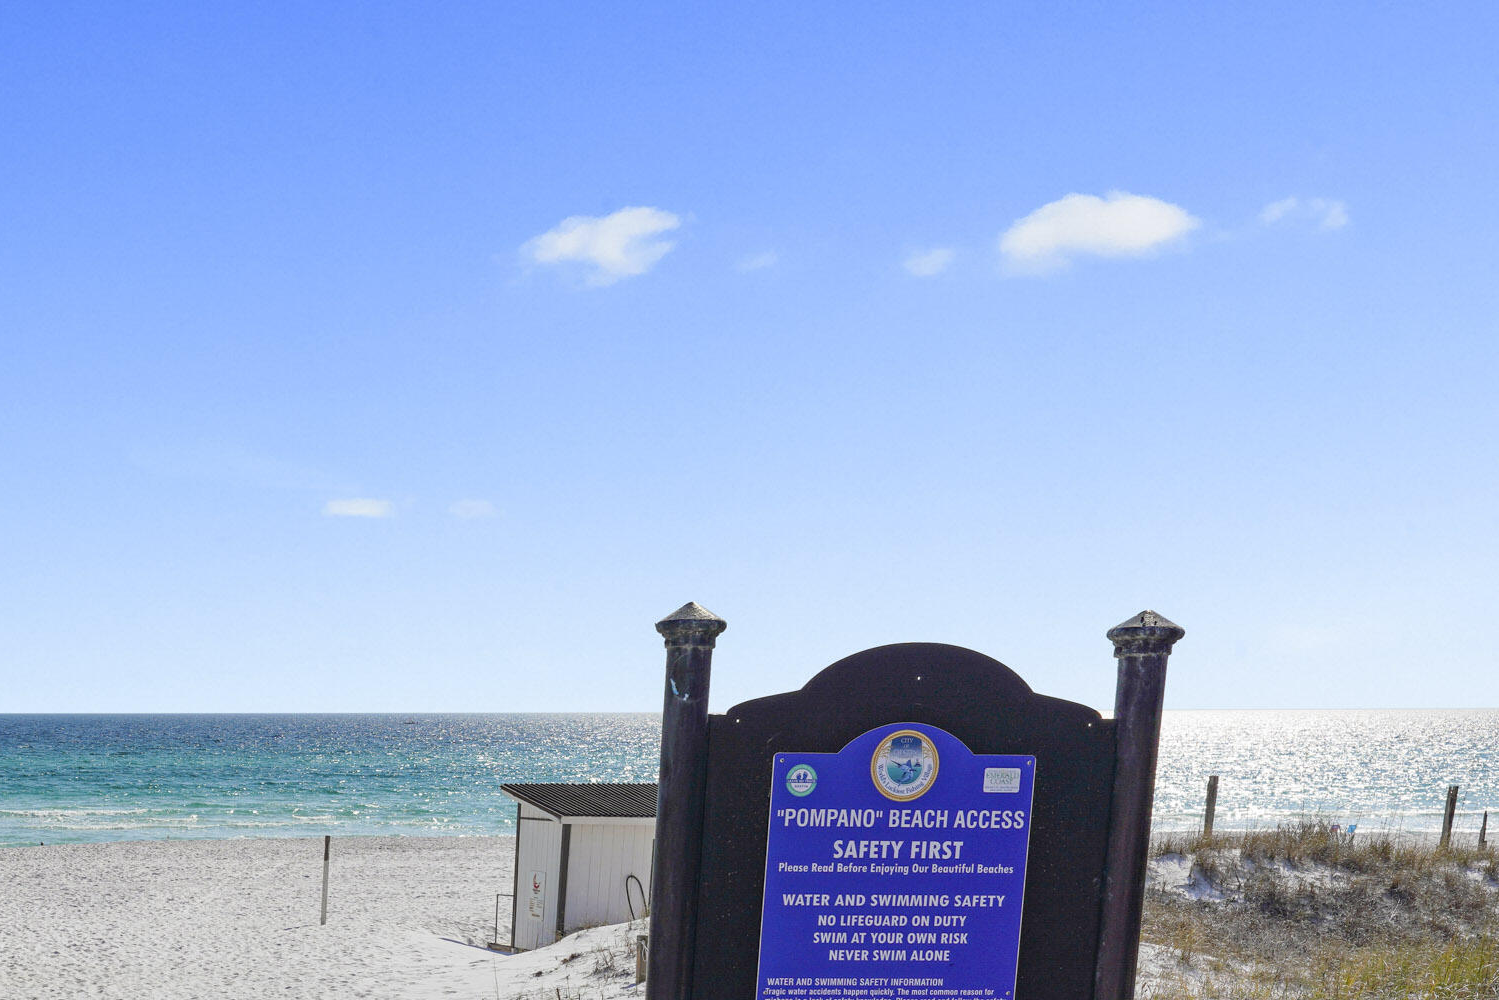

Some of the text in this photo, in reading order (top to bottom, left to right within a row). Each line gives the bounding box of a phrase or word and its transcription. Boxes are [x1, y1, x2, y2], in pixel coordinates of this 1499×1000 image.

[777, 808, 1024, 829] "POMPANO" BEACH ACCESS
[833, 840, 964, 859] SAFETY FIRST
[779, 862, 1013, 875] Please Read Before Enjoying Our Beautiful Beaches
[782, 894, 1005, 907] WATER AND SWIMMING SAFETY
[818, 915, 967, 926] NO LIFEGUARD ON DUTY
[813, 932, 968, 944] SWIM AT YOUR OWN RISK
[829, 950, 950, 961] NEVER SWIM ALONE
[795, 978, 813, 986] AND
[814, 978, 858, 986] SWIMMING
[859, 978, 889, 986] SAFETY
[765, 988, 786, 996] Tragic
[843, 988, 868, 996] happen
